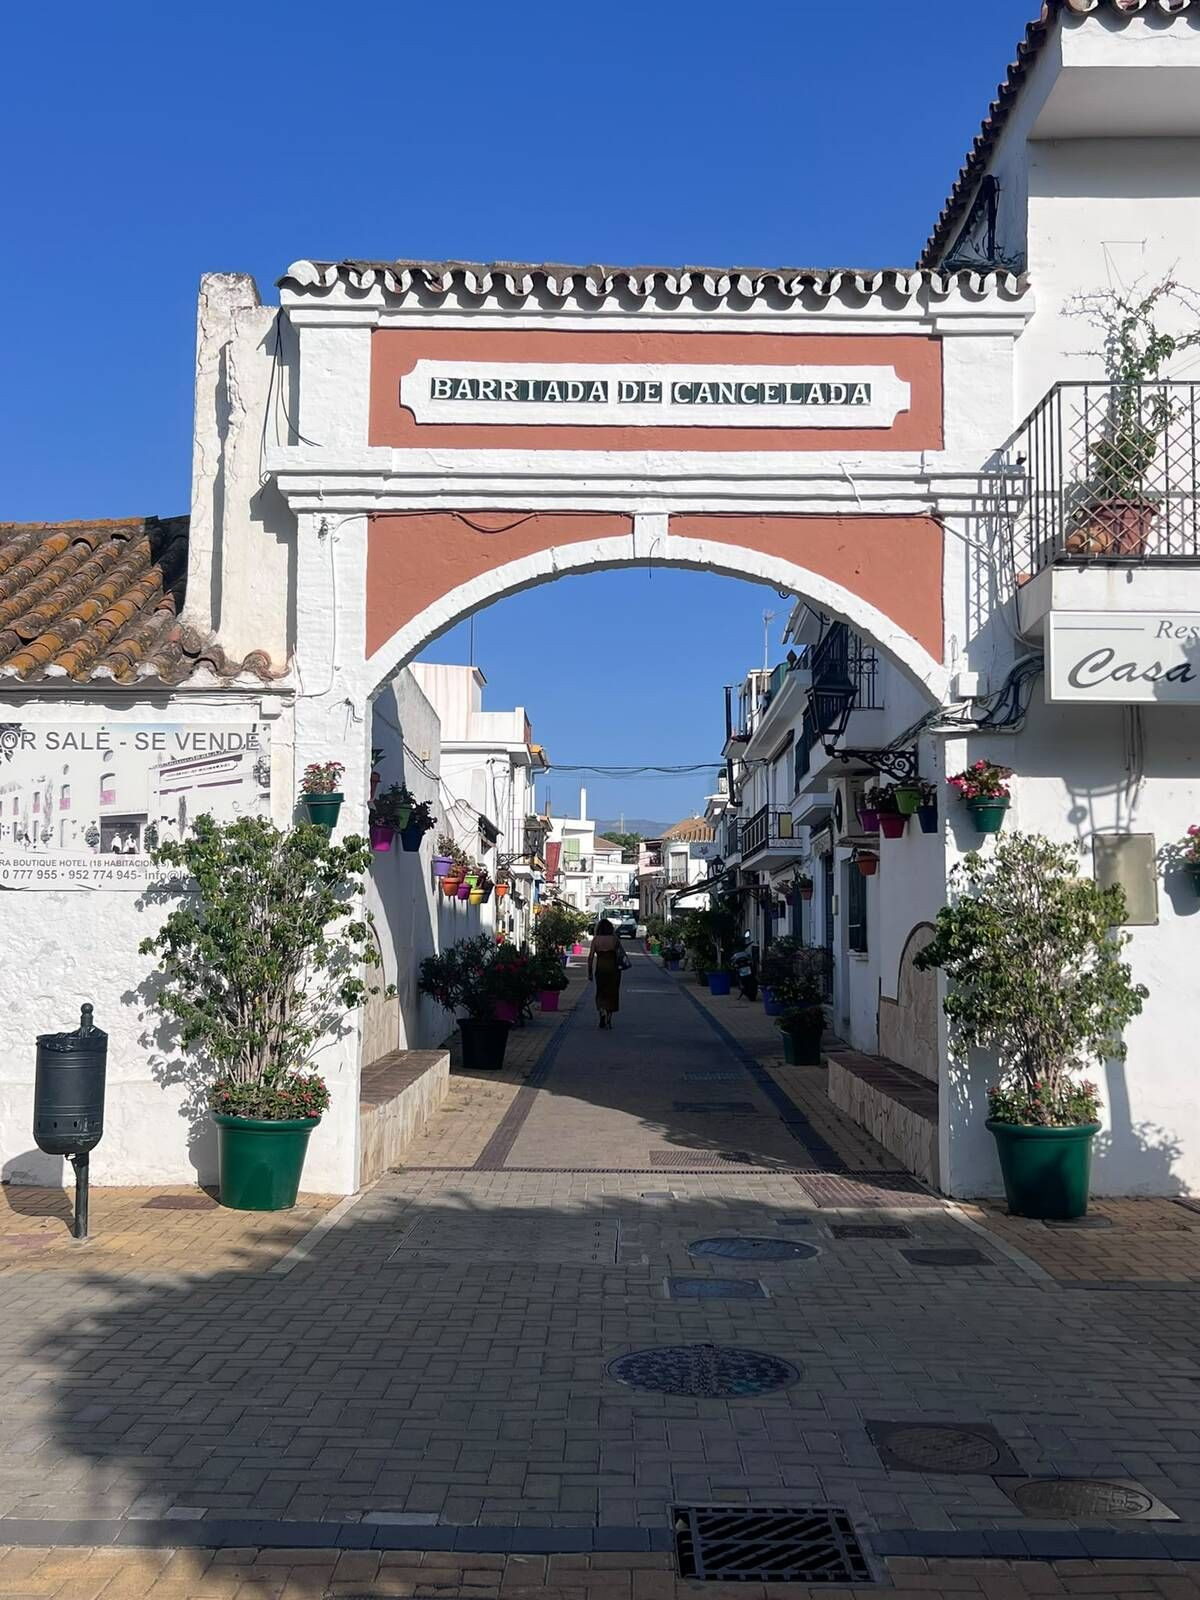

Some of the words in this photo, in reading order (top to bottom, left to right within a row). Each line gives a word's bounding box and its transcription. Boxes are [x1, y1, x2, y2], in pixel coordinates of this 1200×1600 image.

[432, 377, 608, 401] BARRIADA
[620, 381, 661, 402] DE
[673, 382, 869, 404] CANCELADA
[1154, 620, 1200, 639] Res
[1068, 647, 1197, 689] Casa
[45, 732, 110, 751] SALE
[135, 732, 166, 751] SE
[176, 732, 261, 751] VENDE
[13, 859, 57, 868] BOUTIQUE
[59, 859, 87, 868] HOTEL
[90, 859, 102, 869] (18
[13, 869, 33, 879] 777
[36, 869, 57, 879] 955
[68, 869, 89, 879] 952
[93, 869, 113, 880] 774
